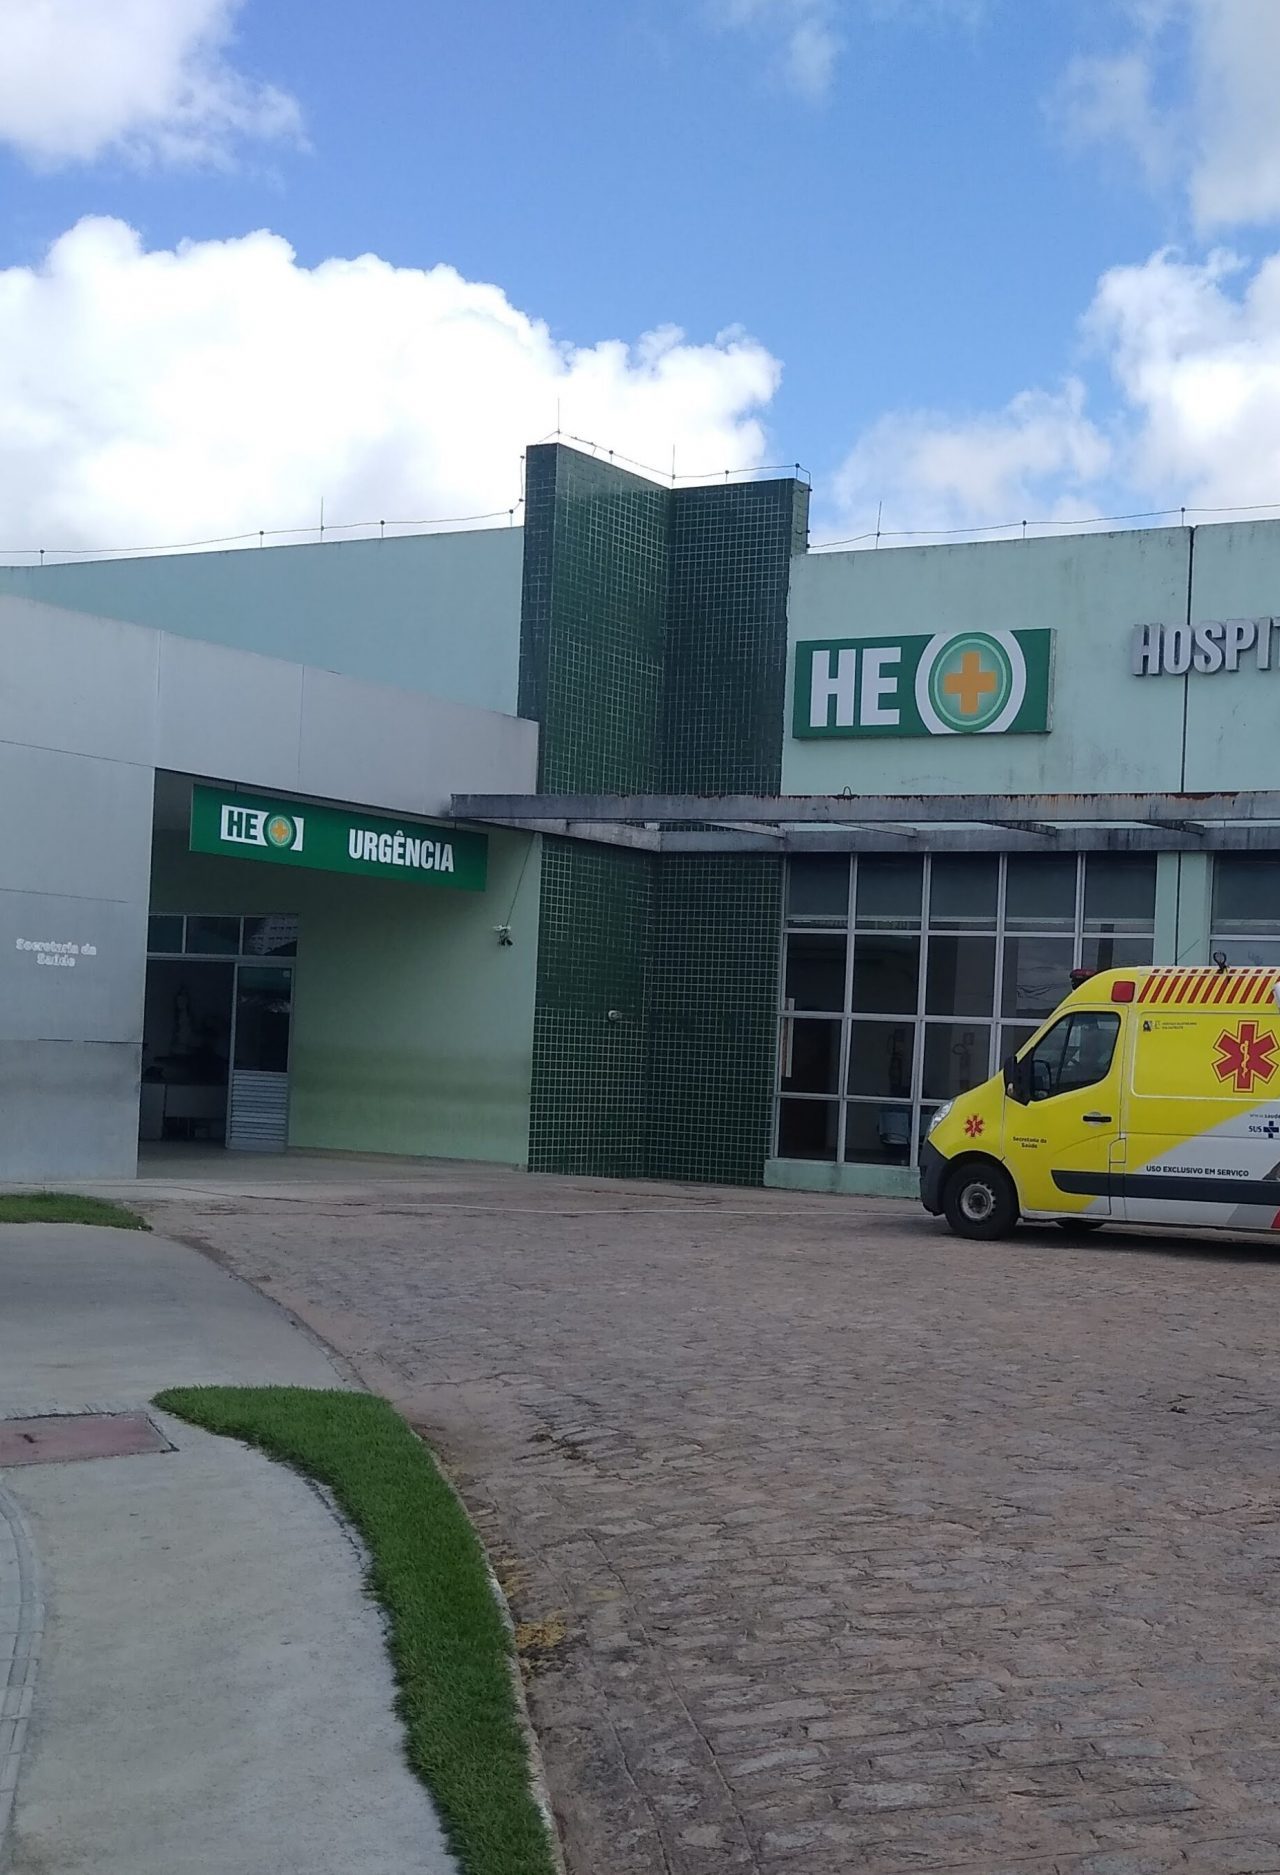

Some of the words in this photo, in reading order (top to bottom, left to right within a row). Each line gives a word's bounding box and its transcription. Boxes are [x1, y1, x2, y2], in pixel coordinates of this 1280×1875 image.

[809, 646, 901, 727] HE
[348, 828, 454, 873] URGÊNCIA
[81, 943, 97, 955] da
[1248, 1125, 1263, 1133] SUS
[1145, 1165, 1162, 1173] USO
[1163, 1166, 1203, 1175] EXCLUSIVO
[1216, 1168, 1249, 1178] SERVIÇO
